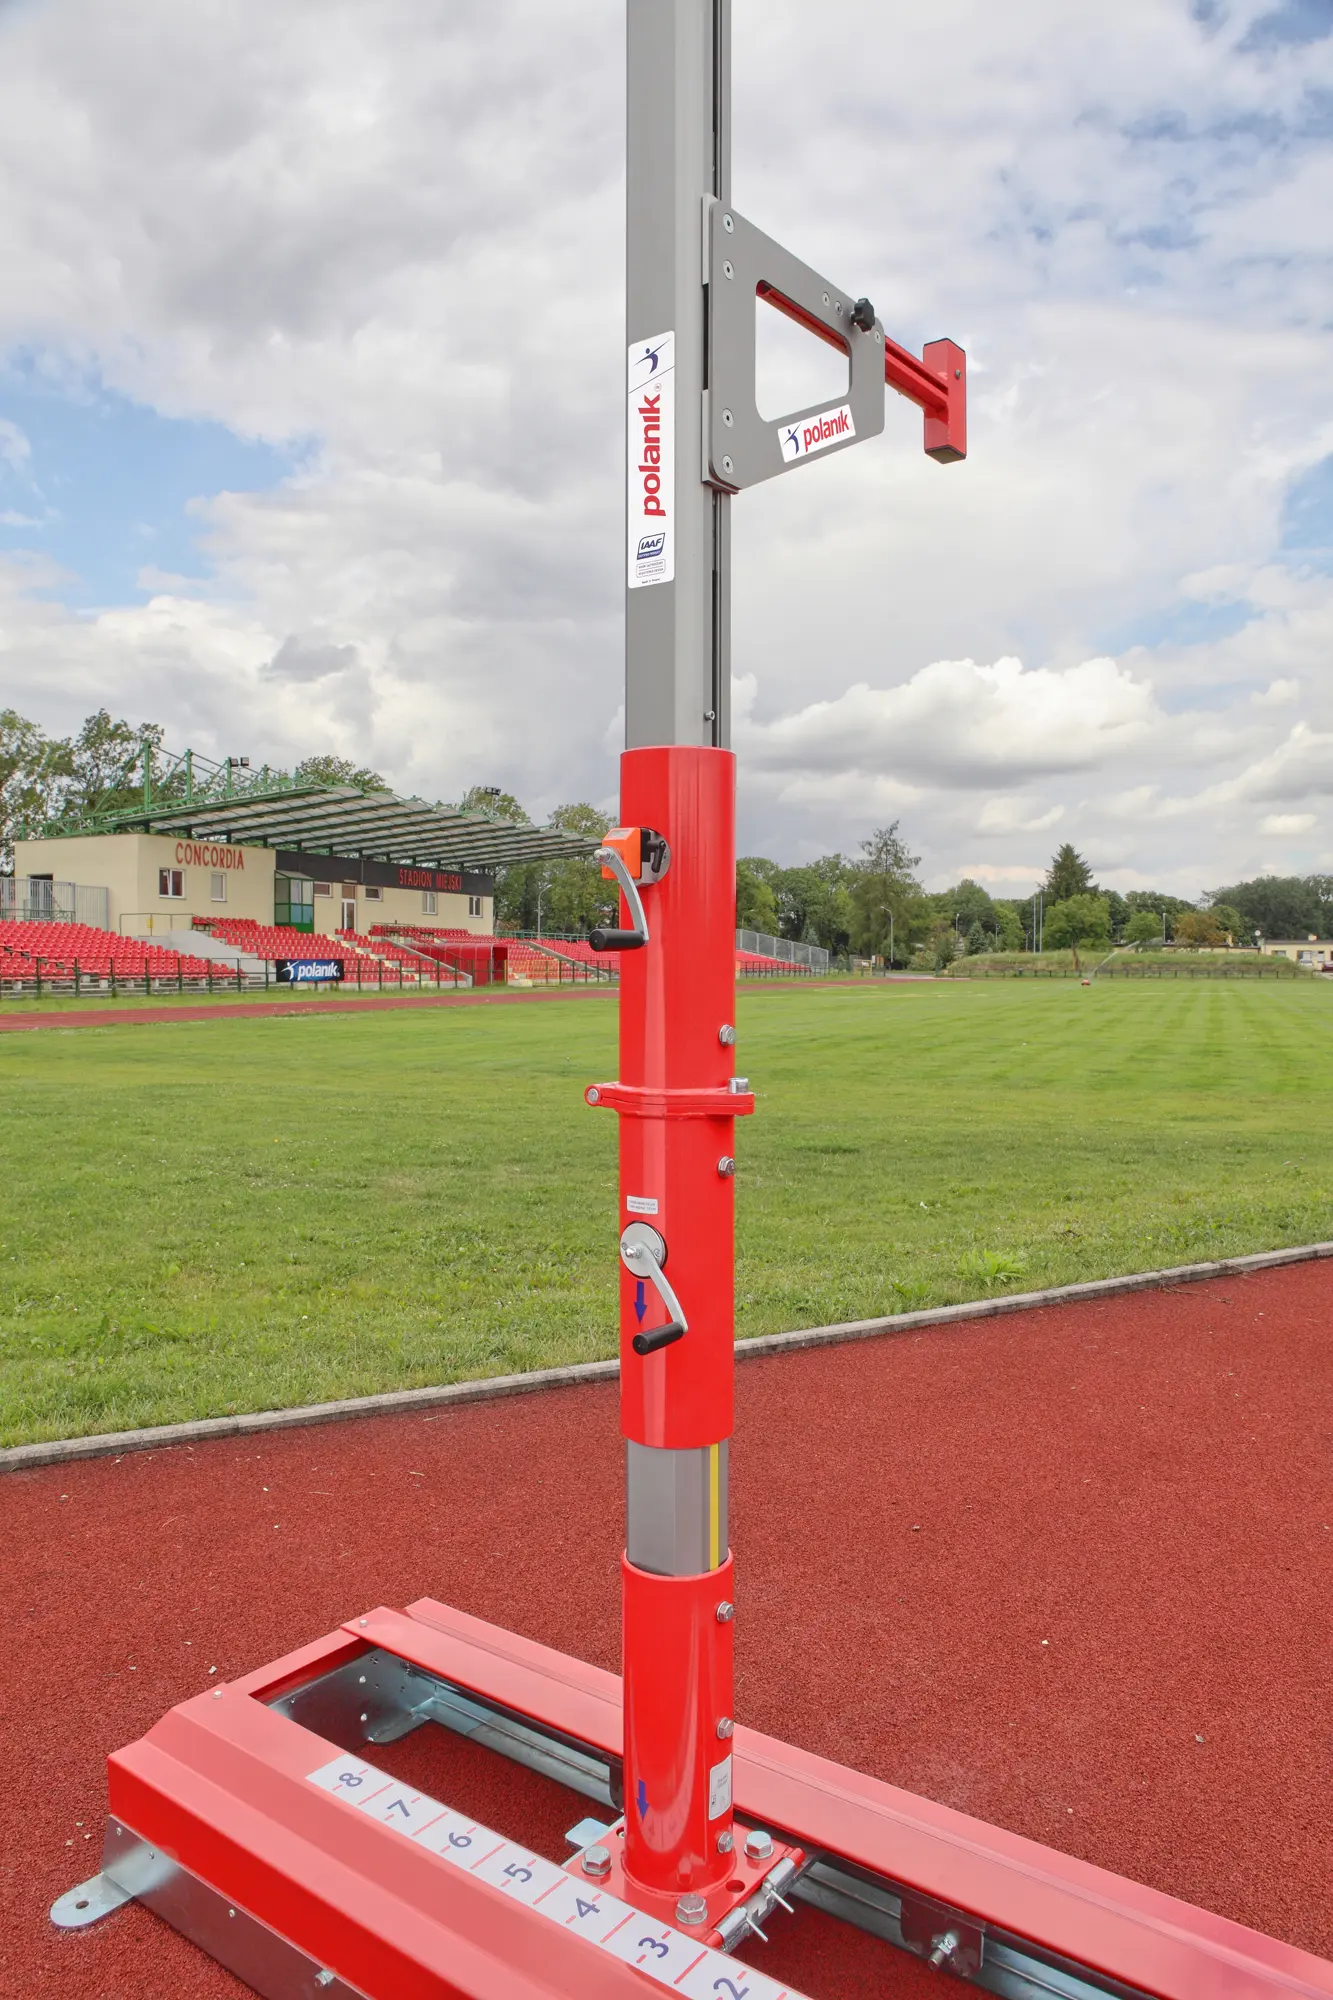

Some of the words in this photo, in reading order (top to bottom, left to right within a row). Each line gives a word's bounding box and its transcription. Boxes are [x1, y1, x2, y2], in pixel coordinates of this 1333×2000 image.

[803, 409, 850, 453] polanik
[638, 393, 666, 517] polanik
[640, 537, 663, 550] IAAF
[175, 842, 245, 870] CONCORDIA
[399, 868, 432, 888] STADION
[435, 872, 462, 890] MIEJSKI
[297, 961, 338, 981] polanik
[338, 1772, 364, 1788] 8
[386, 1799, 411, 1818] 7
[448, 1832, 472, 1848] 6
[503, 1863, 533, 1883] 5
[575, 1897, 601, 1918] 4
[637, 1936, 670, 1959] 3
[712, 1977, 750, 2000] 2
